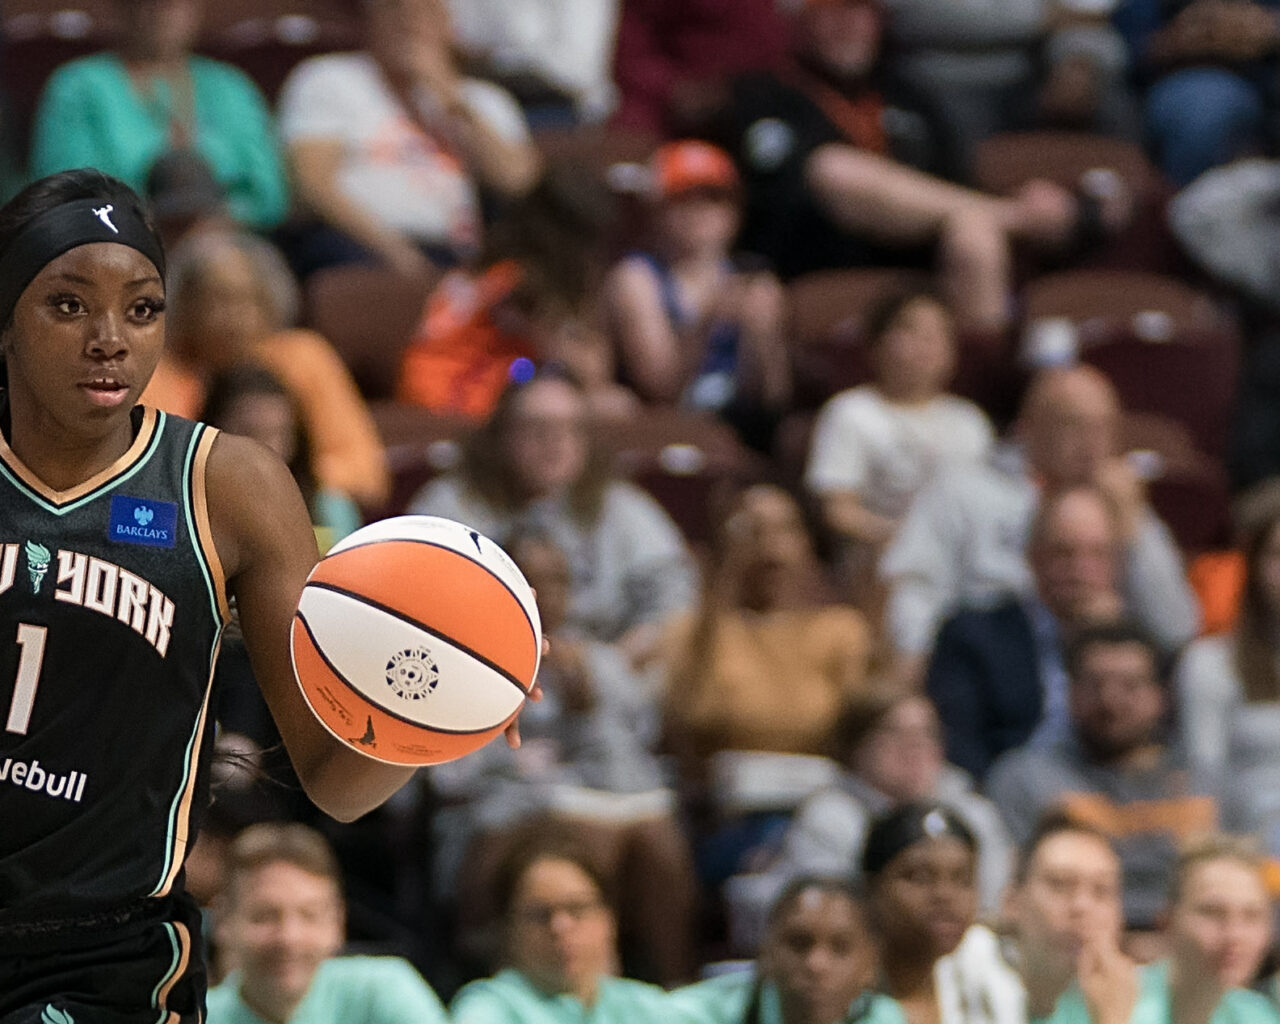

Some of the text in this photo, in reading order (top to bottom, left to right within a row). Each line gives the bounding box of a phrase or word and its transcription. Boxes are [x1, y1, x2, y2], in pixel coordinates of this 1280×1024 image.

[116, 524, 168, 540] BARCLAYS
[55, 549, 175, 659] YORK
[5, 622, 48, 735] 1
